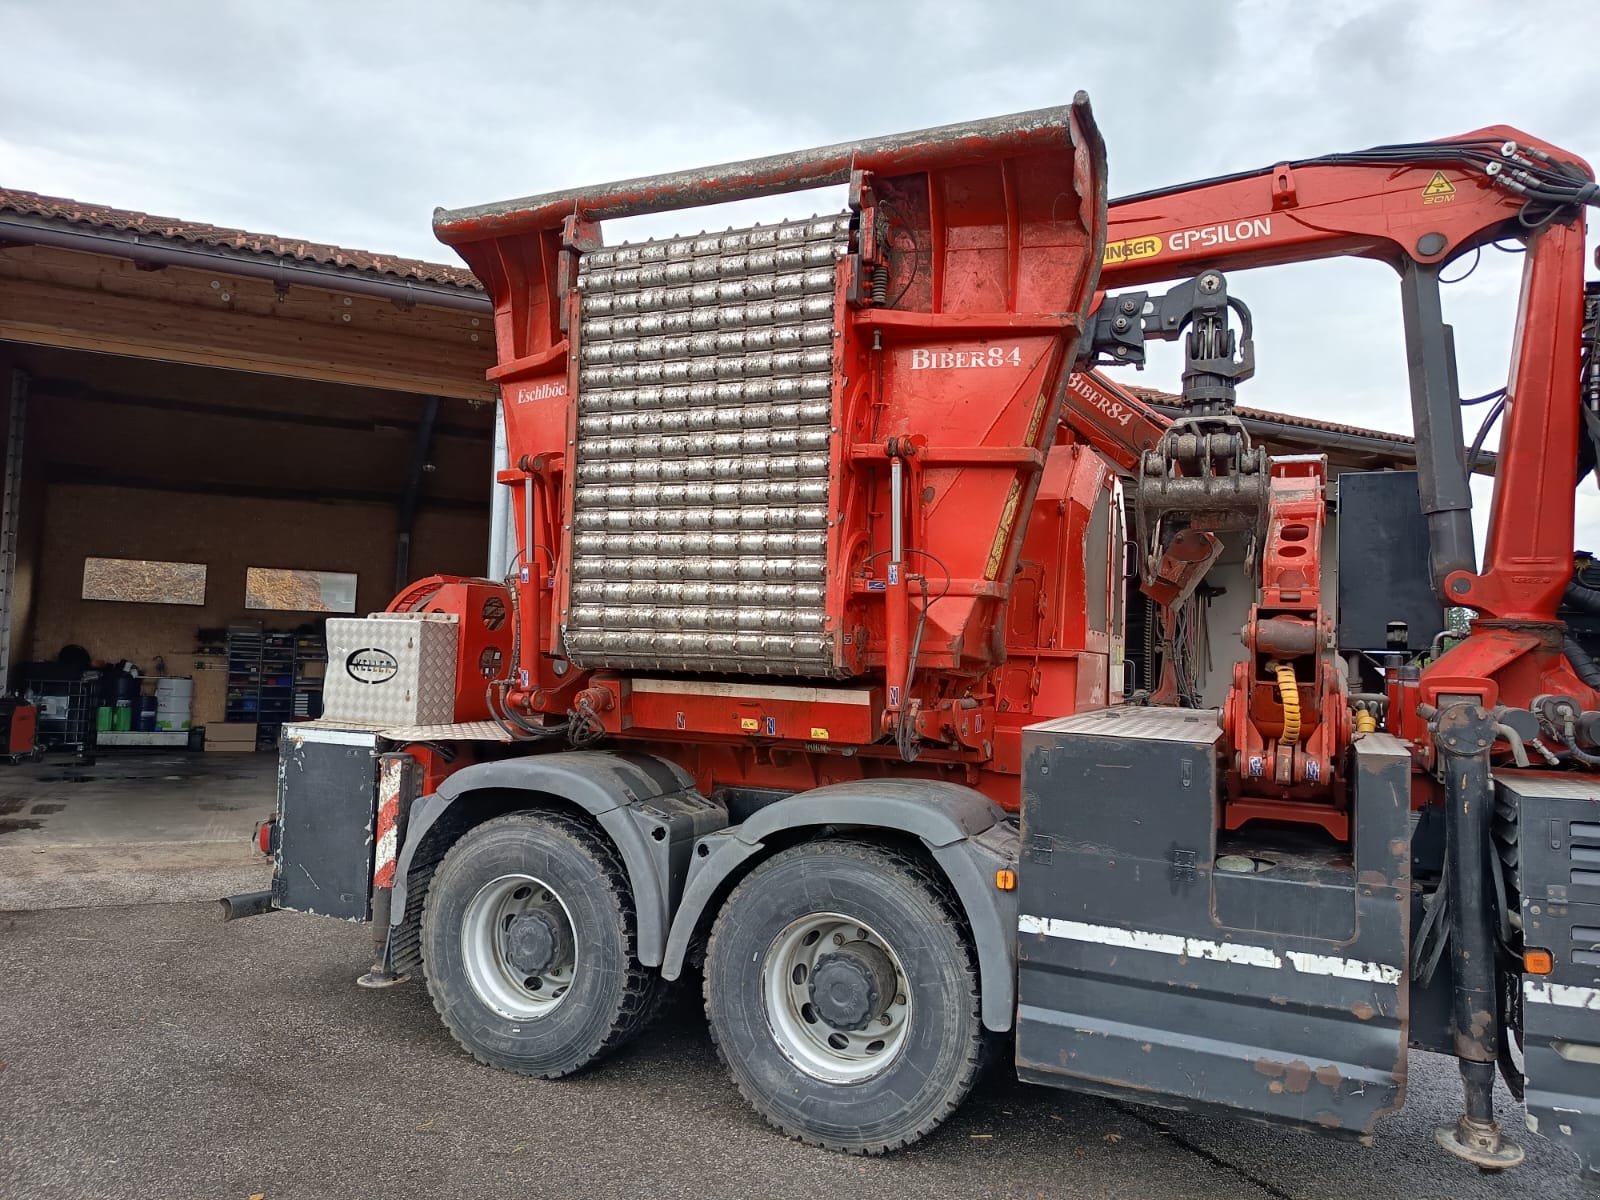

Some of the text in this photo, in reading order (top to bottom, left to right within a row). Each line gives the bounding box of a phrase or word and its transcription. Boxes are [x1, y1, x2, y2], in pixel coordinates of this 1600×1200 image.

[1168, 218, 1271, 250] EPSILON
[911, 347, 1022, 370] BIBER84
[353, 659, 392, 673] KELLER
